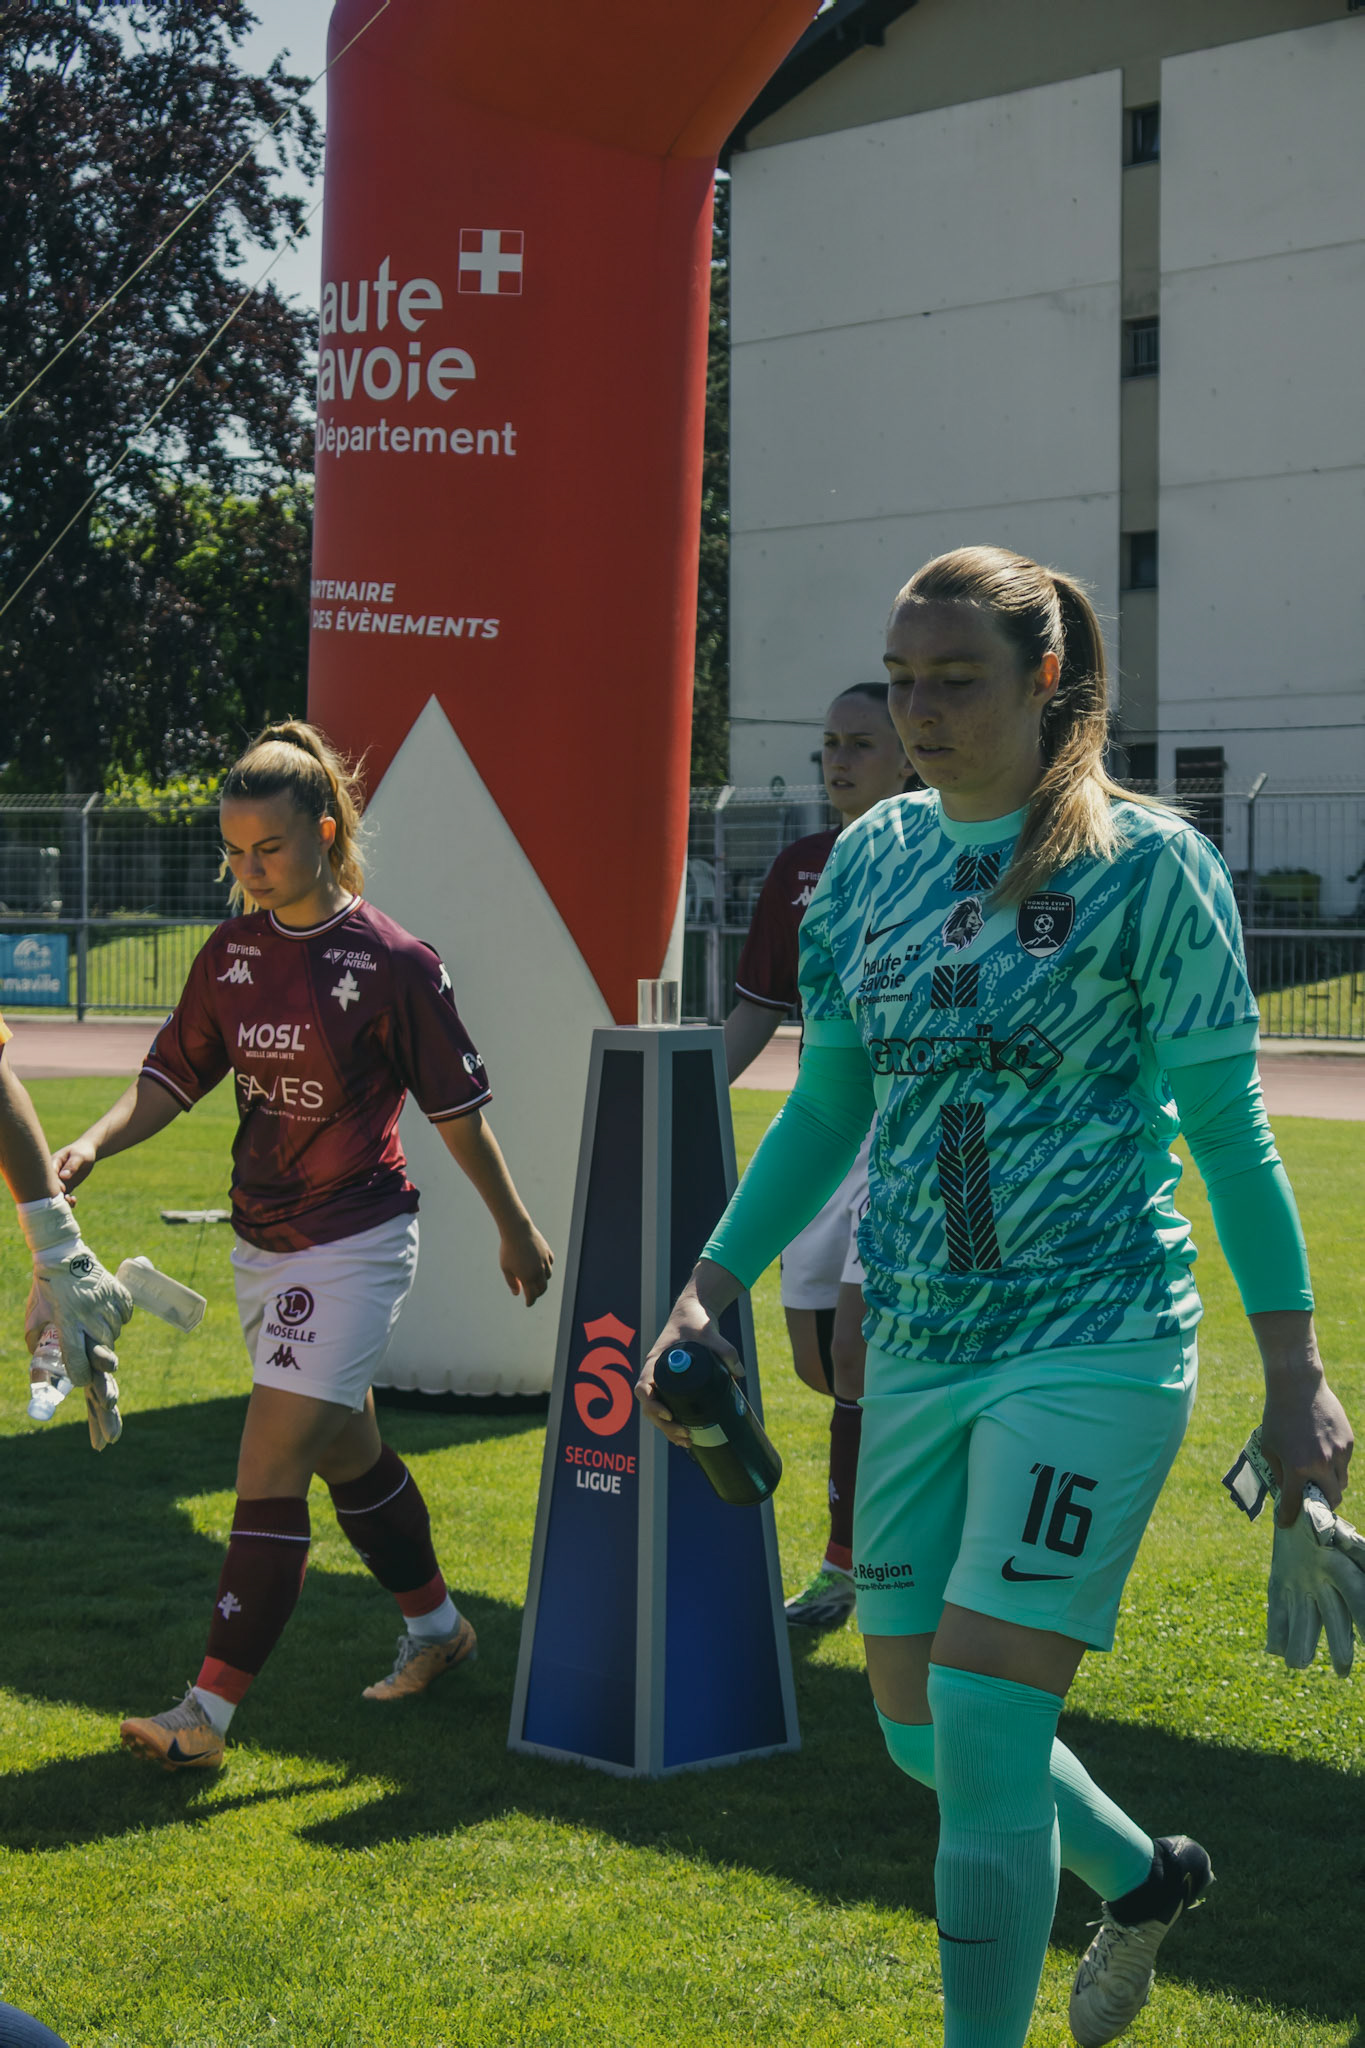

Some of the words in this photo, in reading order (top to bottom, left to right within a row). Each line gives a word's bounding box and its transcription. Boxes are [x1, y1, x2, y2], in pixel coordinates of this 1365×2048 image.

[321, 255, 444, 334] aute
[319, 342, 476, 401] avoie
[317, 416, 517, 458] Département
[311, 579, 396, 602] ARTENAIRE
[312, 609, 333, 630] DES
[335, 606, 501, 639] ÉVÈNEMENTS
[342, 959, 377, 971] INTERIM
[347, 950, 371, 961] axia
[863, 953, 902, 977] haute
[858, 973, 906, 993] savoie
[975, 1023, 994, 1036] TP
[868, 1037, 995, 1077] GROPPI
[266, 1322, 317, 1343] MOSELLE
[565, 1445, 636, 1475] SECONDE
[576, 1469, 622, 1495] LIGUE
[1021, 1462, 1099, 1558] 16
[859, 1562, 913, 1582] Région
